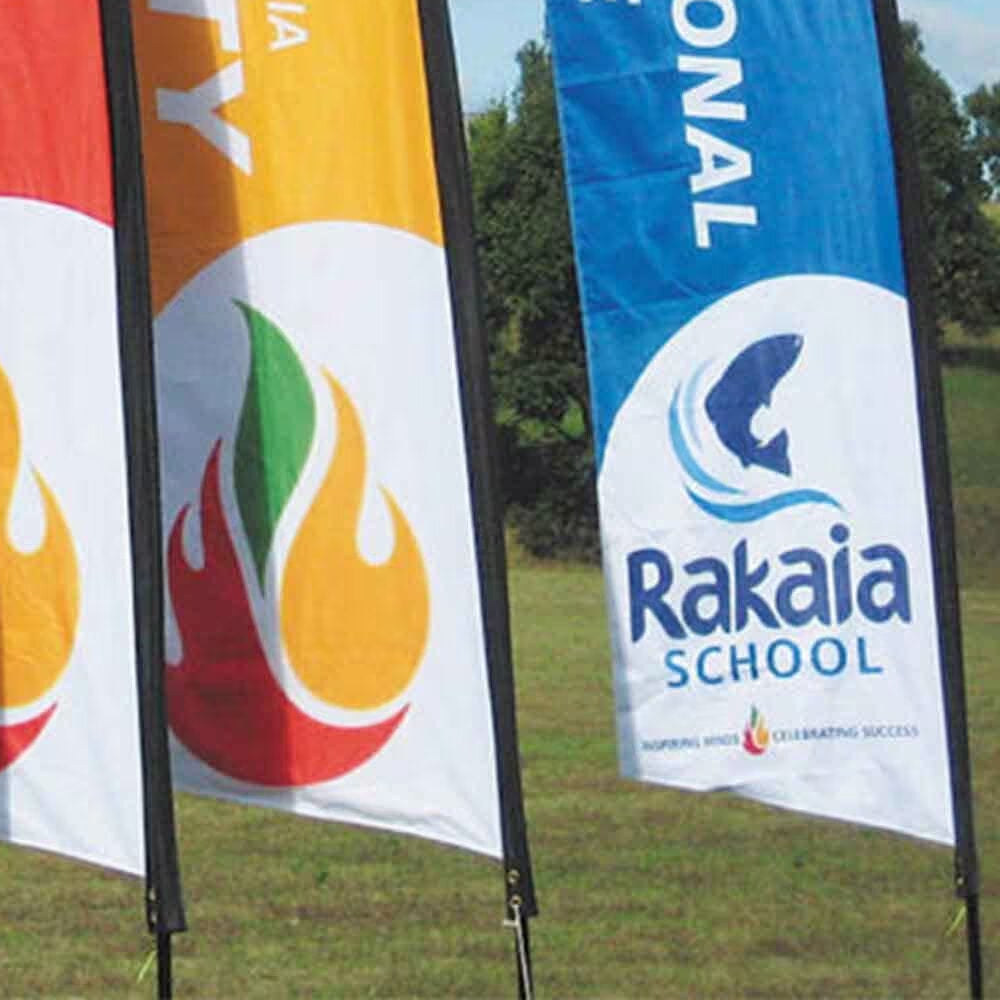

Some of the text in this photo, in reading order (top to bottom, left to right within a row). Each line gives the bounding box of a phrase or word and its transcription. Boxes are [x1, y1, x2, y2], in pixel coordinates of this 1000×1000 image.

[627, 523, 912, 643] Rakaia
[664, 637, 883, 688] SCHOOL
[861, 725, 919, 738] SUCCESS
